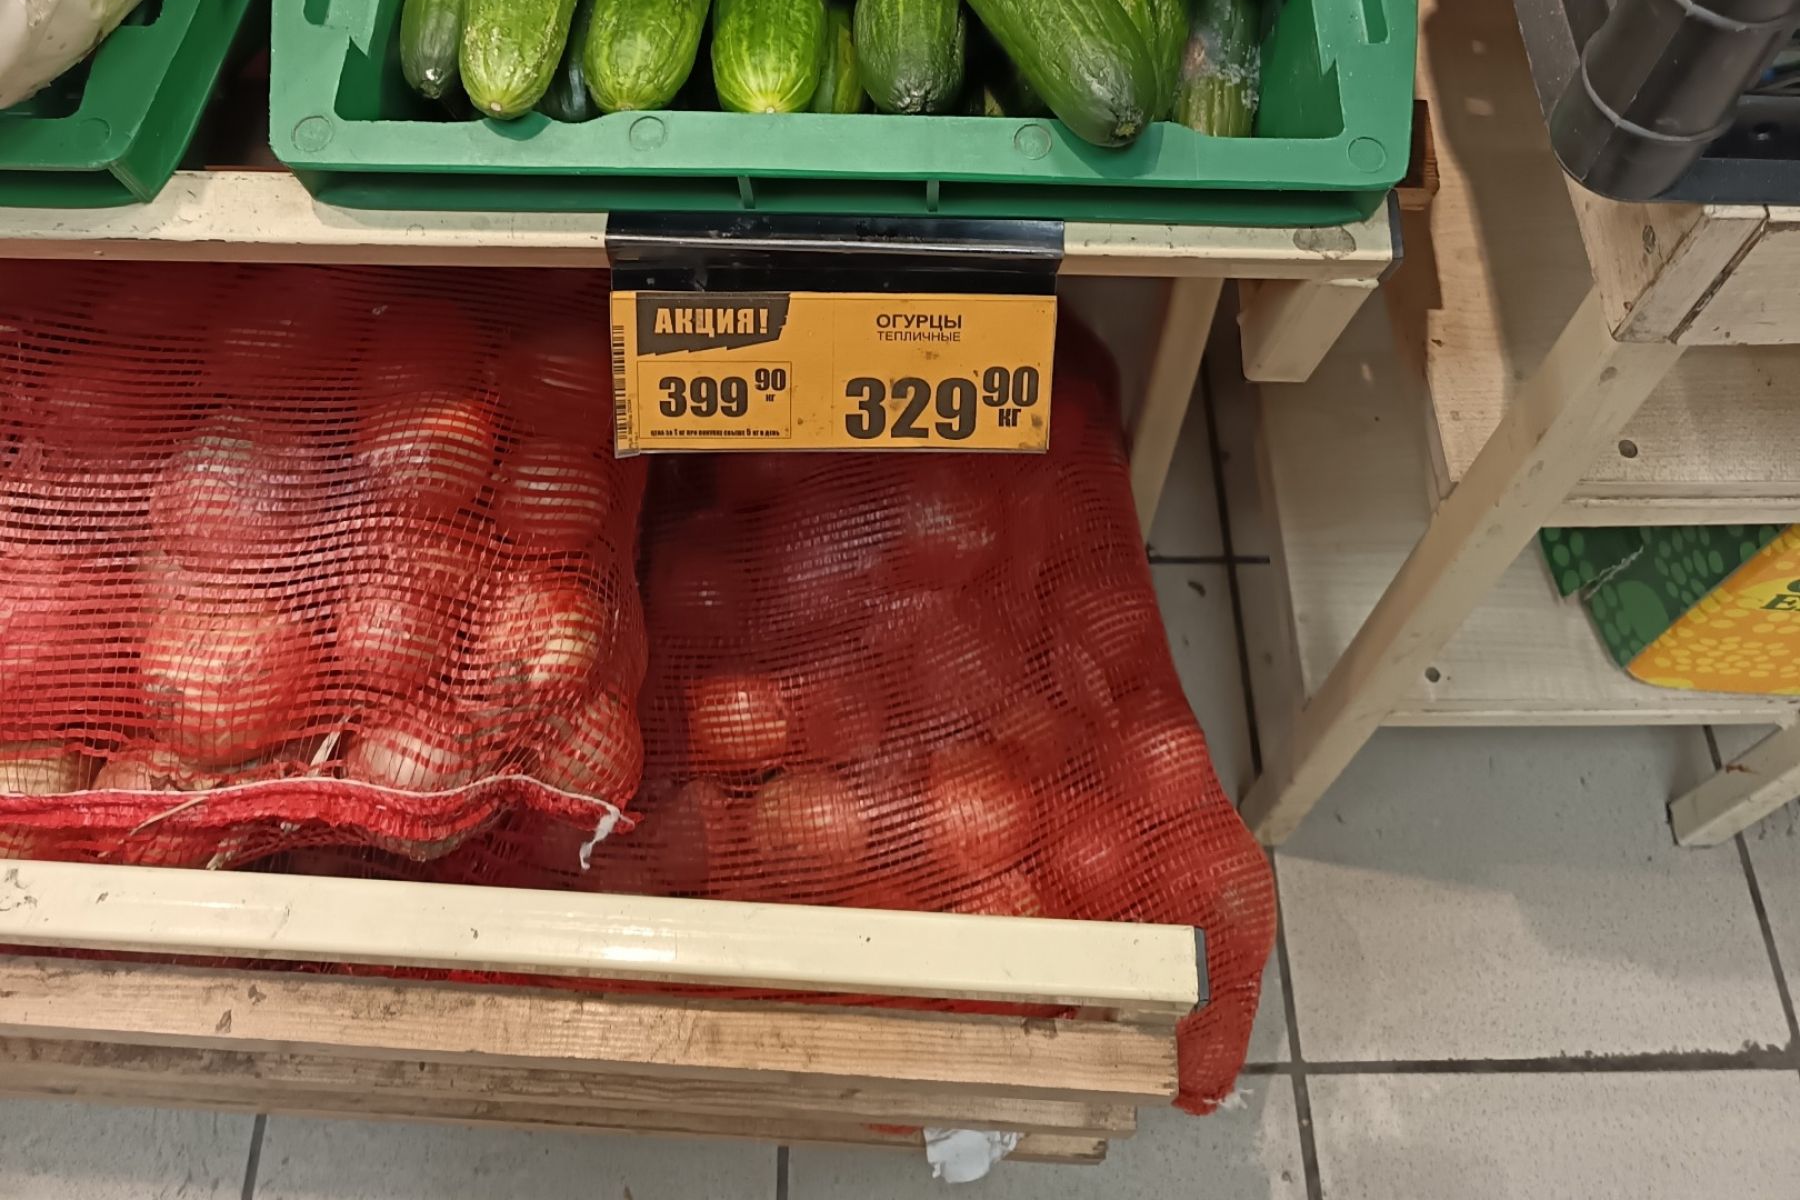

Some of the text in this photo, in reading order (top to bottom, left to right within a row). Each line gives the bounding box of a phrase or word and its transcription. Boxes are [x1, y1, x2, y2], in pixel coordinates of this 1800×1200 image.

[654, 307, 769, 338] АКЦИЯ!
[875, 312, 963, 332] ОГУРЦЫ
[876, 331, 962, 343] ТЕПЛИЧНЫЕ
[658, 368, 787, 418] 399 90
[845, 365, 1040, 440] 329 90
